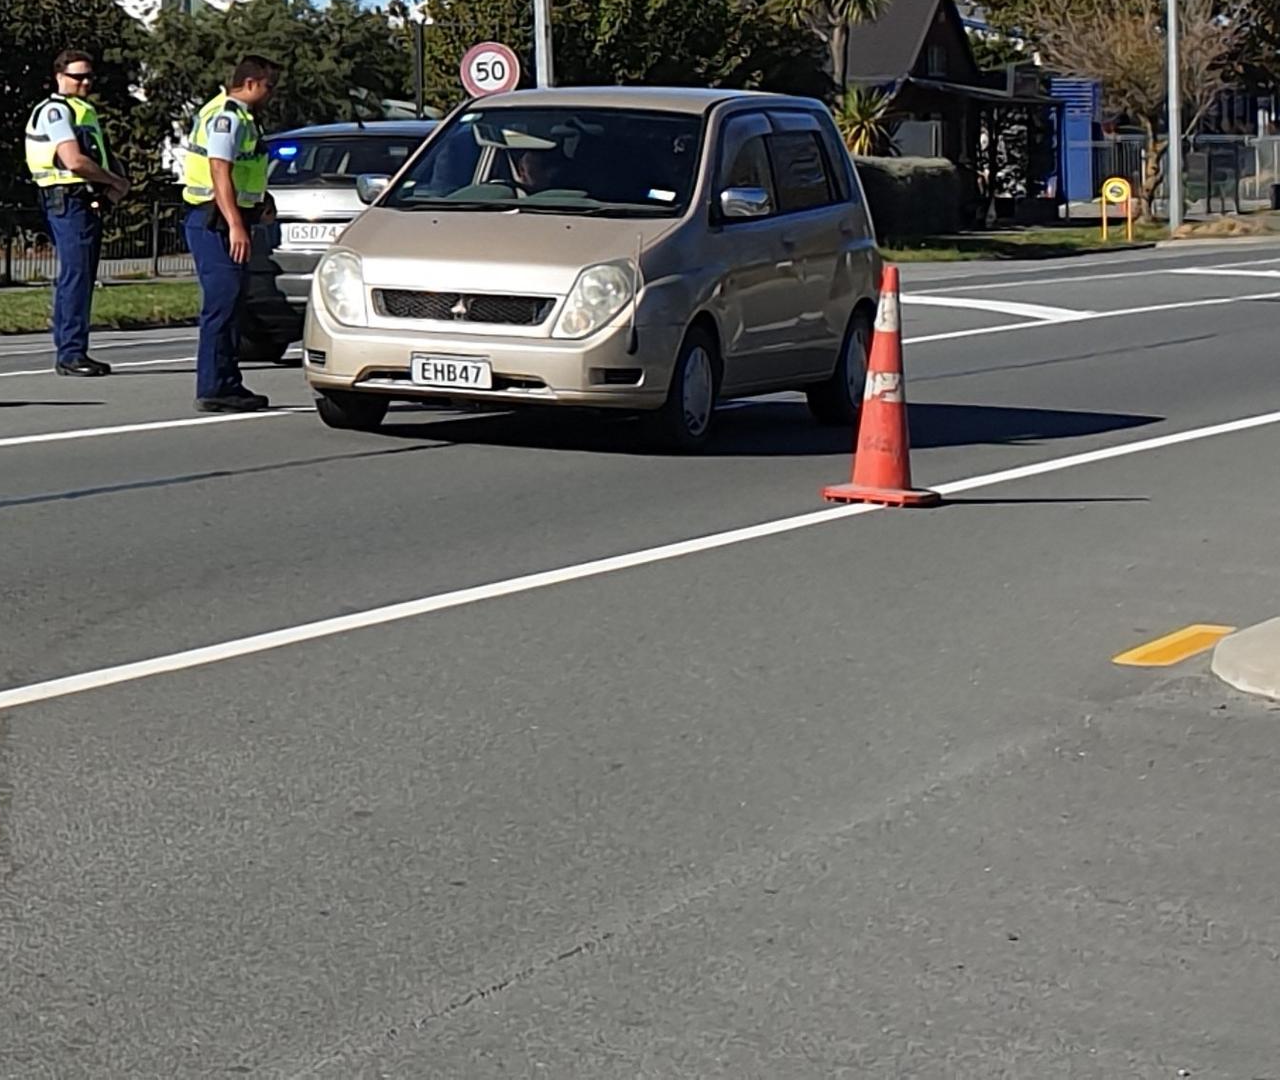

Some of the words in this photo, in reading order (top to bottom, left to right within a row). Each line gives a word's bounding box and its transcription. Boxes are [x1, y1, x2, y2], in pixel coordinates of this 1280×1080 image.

[476, 60, 505, 82] 50
[291, 225, 345, 239] GSD74
[421, 362, 482, 383] EHB47
